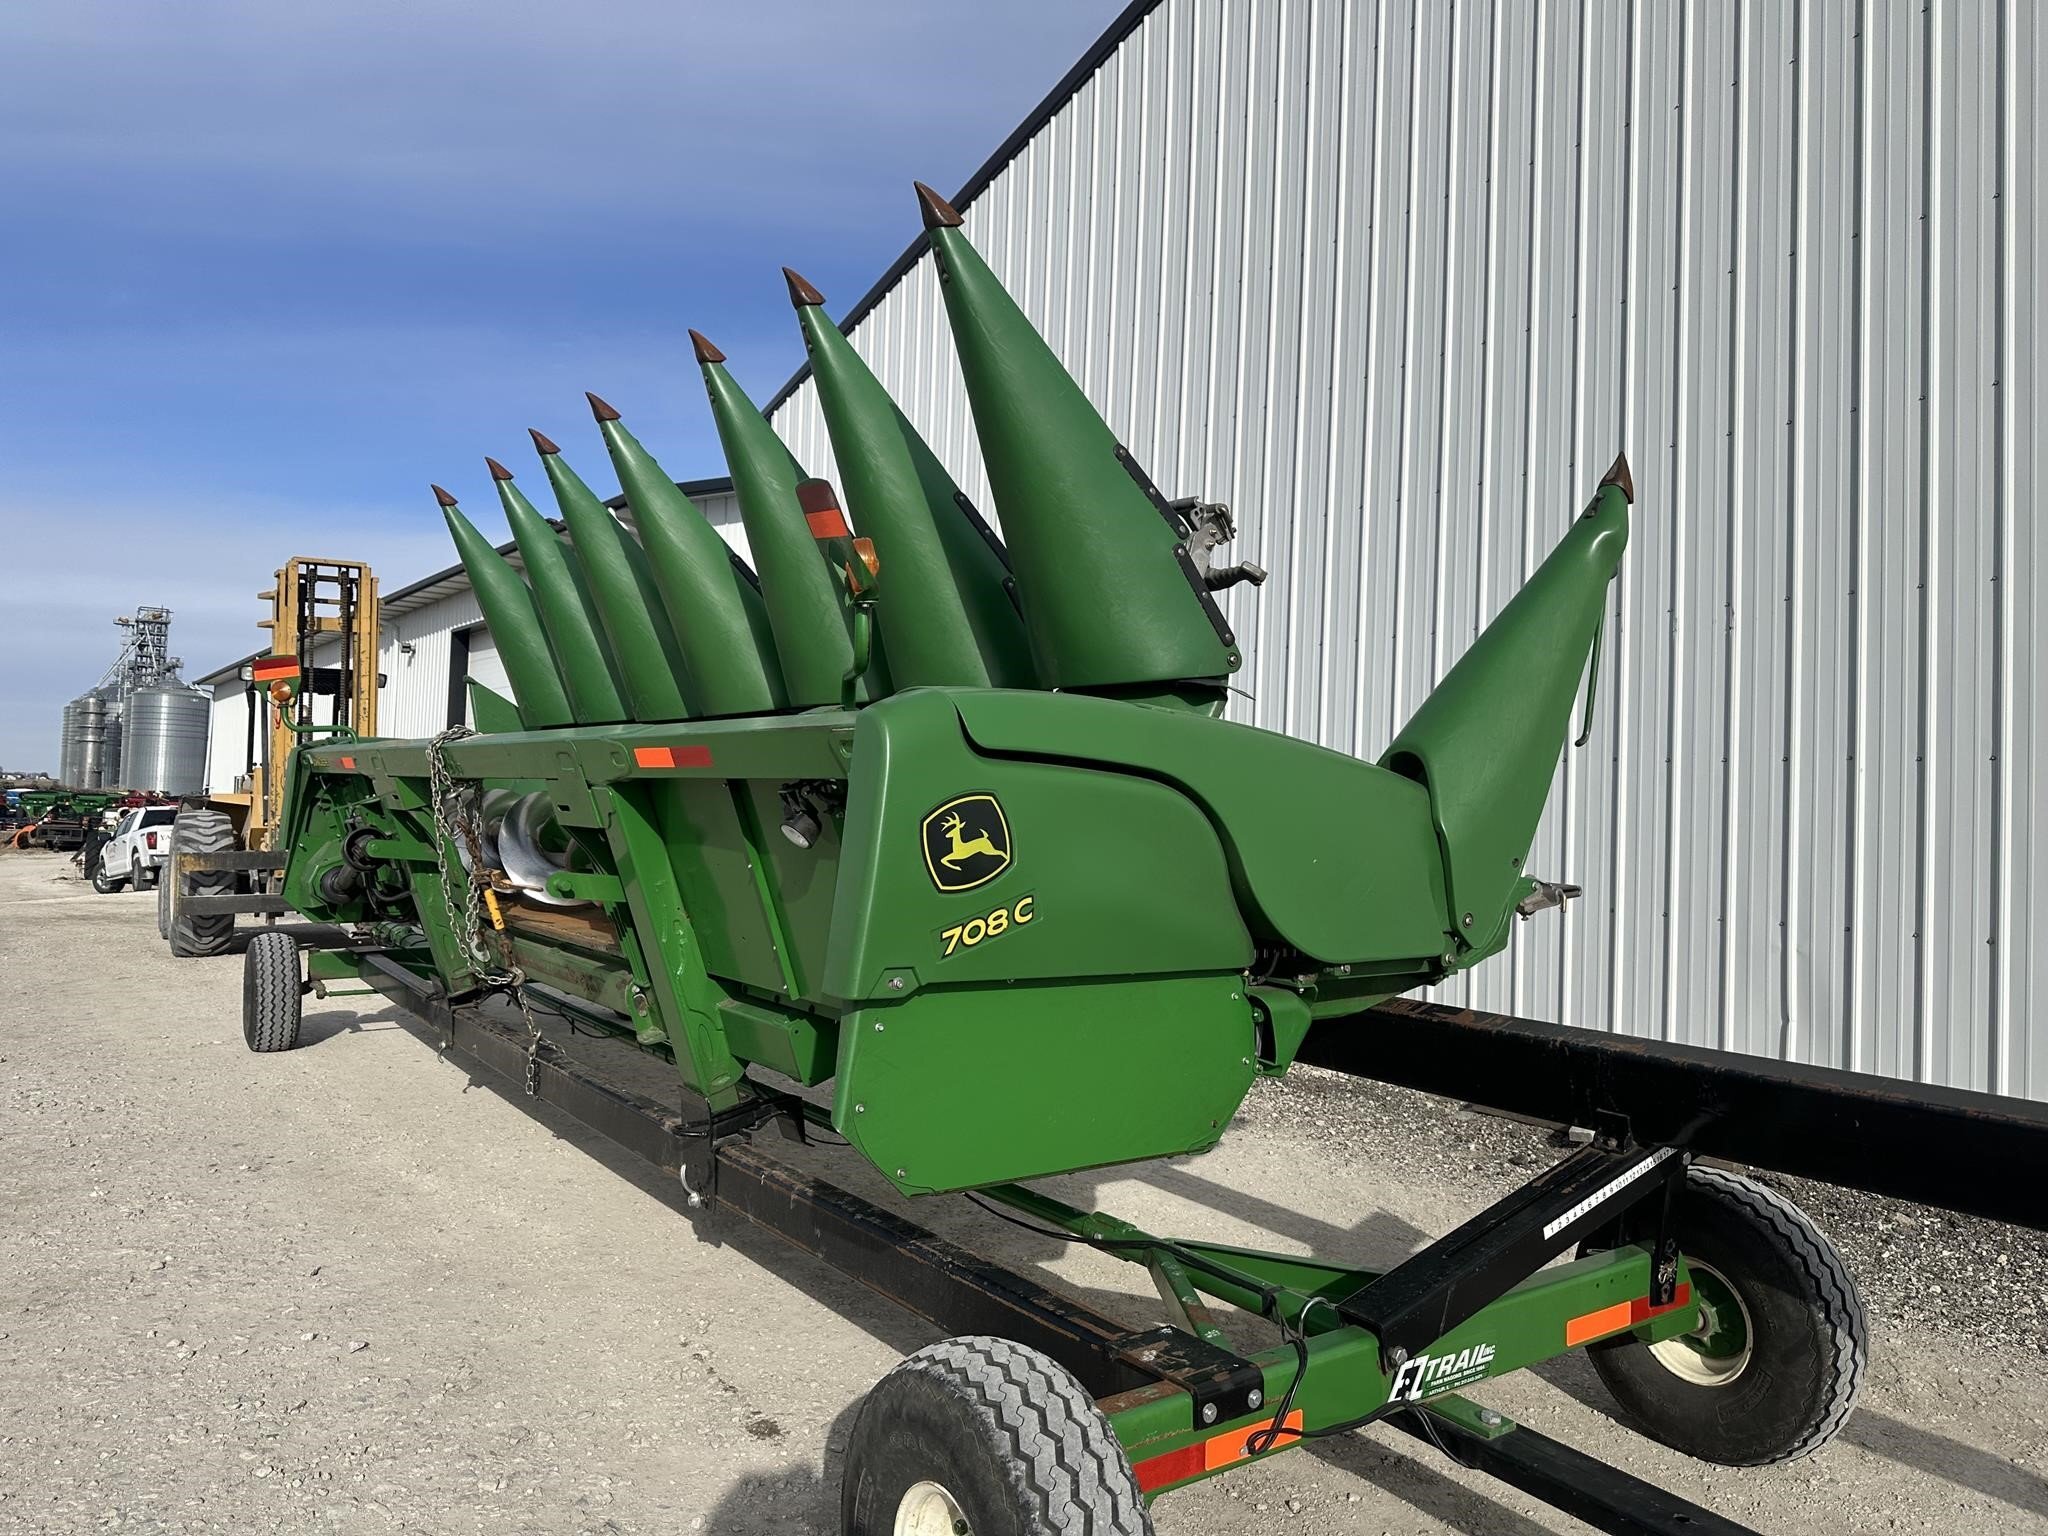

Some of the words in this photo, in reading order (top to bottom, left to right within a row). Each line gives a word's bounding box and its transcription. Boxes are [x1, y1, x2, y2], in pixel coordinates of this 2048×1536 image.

[941, 906, 1009, 958] 708
[1013, 896, 1034, 925] C
[1425, 1343, 1494, 1381] TRAIL
